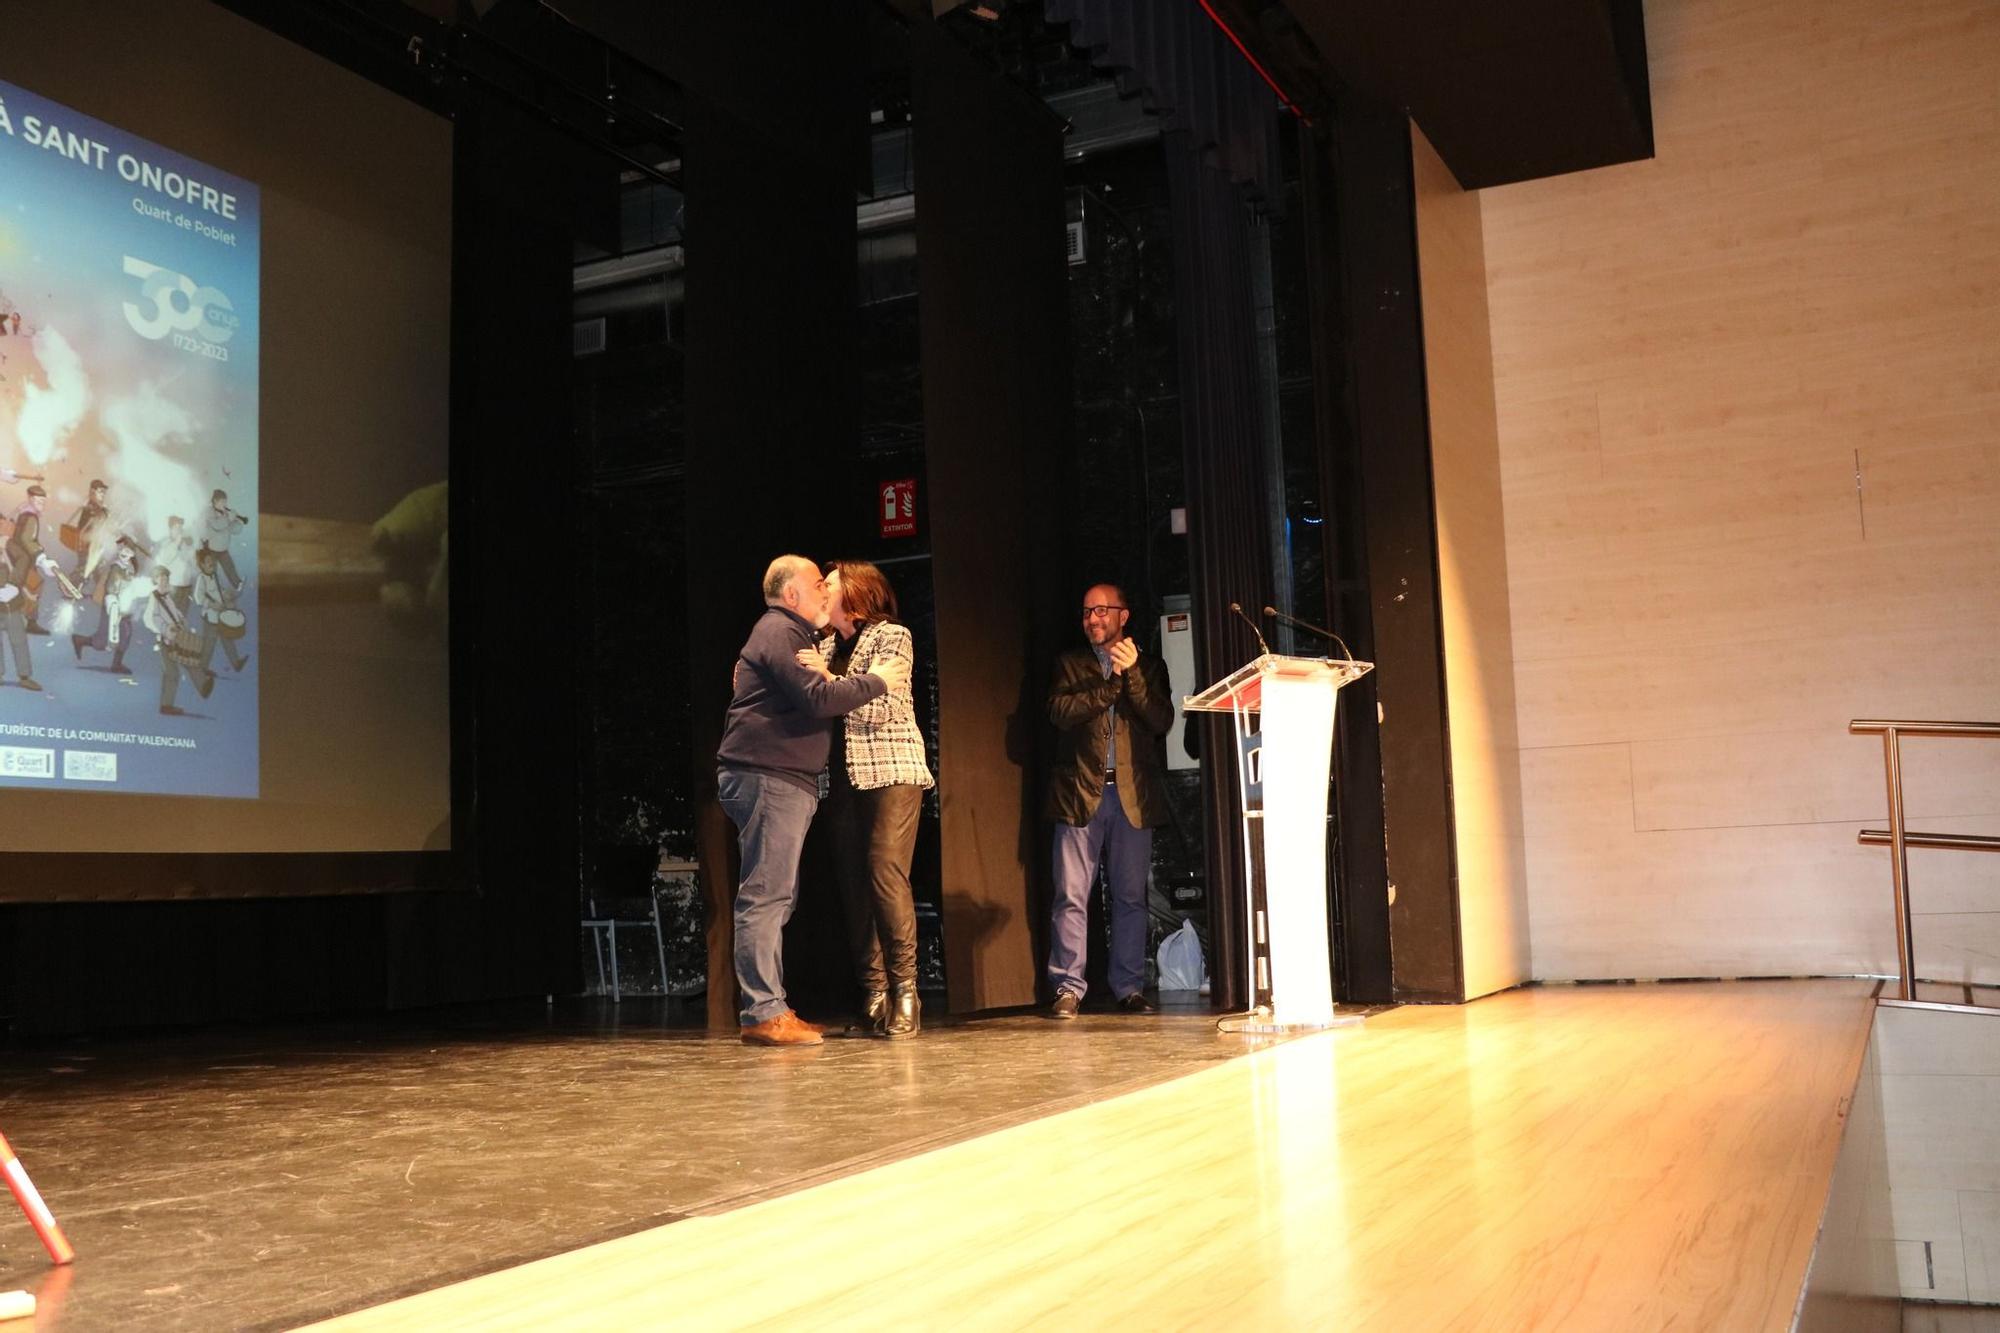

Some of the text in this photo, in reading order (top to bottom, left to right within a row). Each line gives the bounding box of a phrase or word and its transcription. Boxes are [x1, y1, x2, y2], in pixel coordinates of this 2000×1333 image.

[22, 115, 110, 170] SANT
[117, 154, 238, 221] ONOFRE
[132, 198, 237, 247] Quart de Poblet
[883, 523, 913, 532] EXTINTOR
[0, 723, 197, 749] TURÍSTIC DE LA COMUNITAT VALENCIANA
